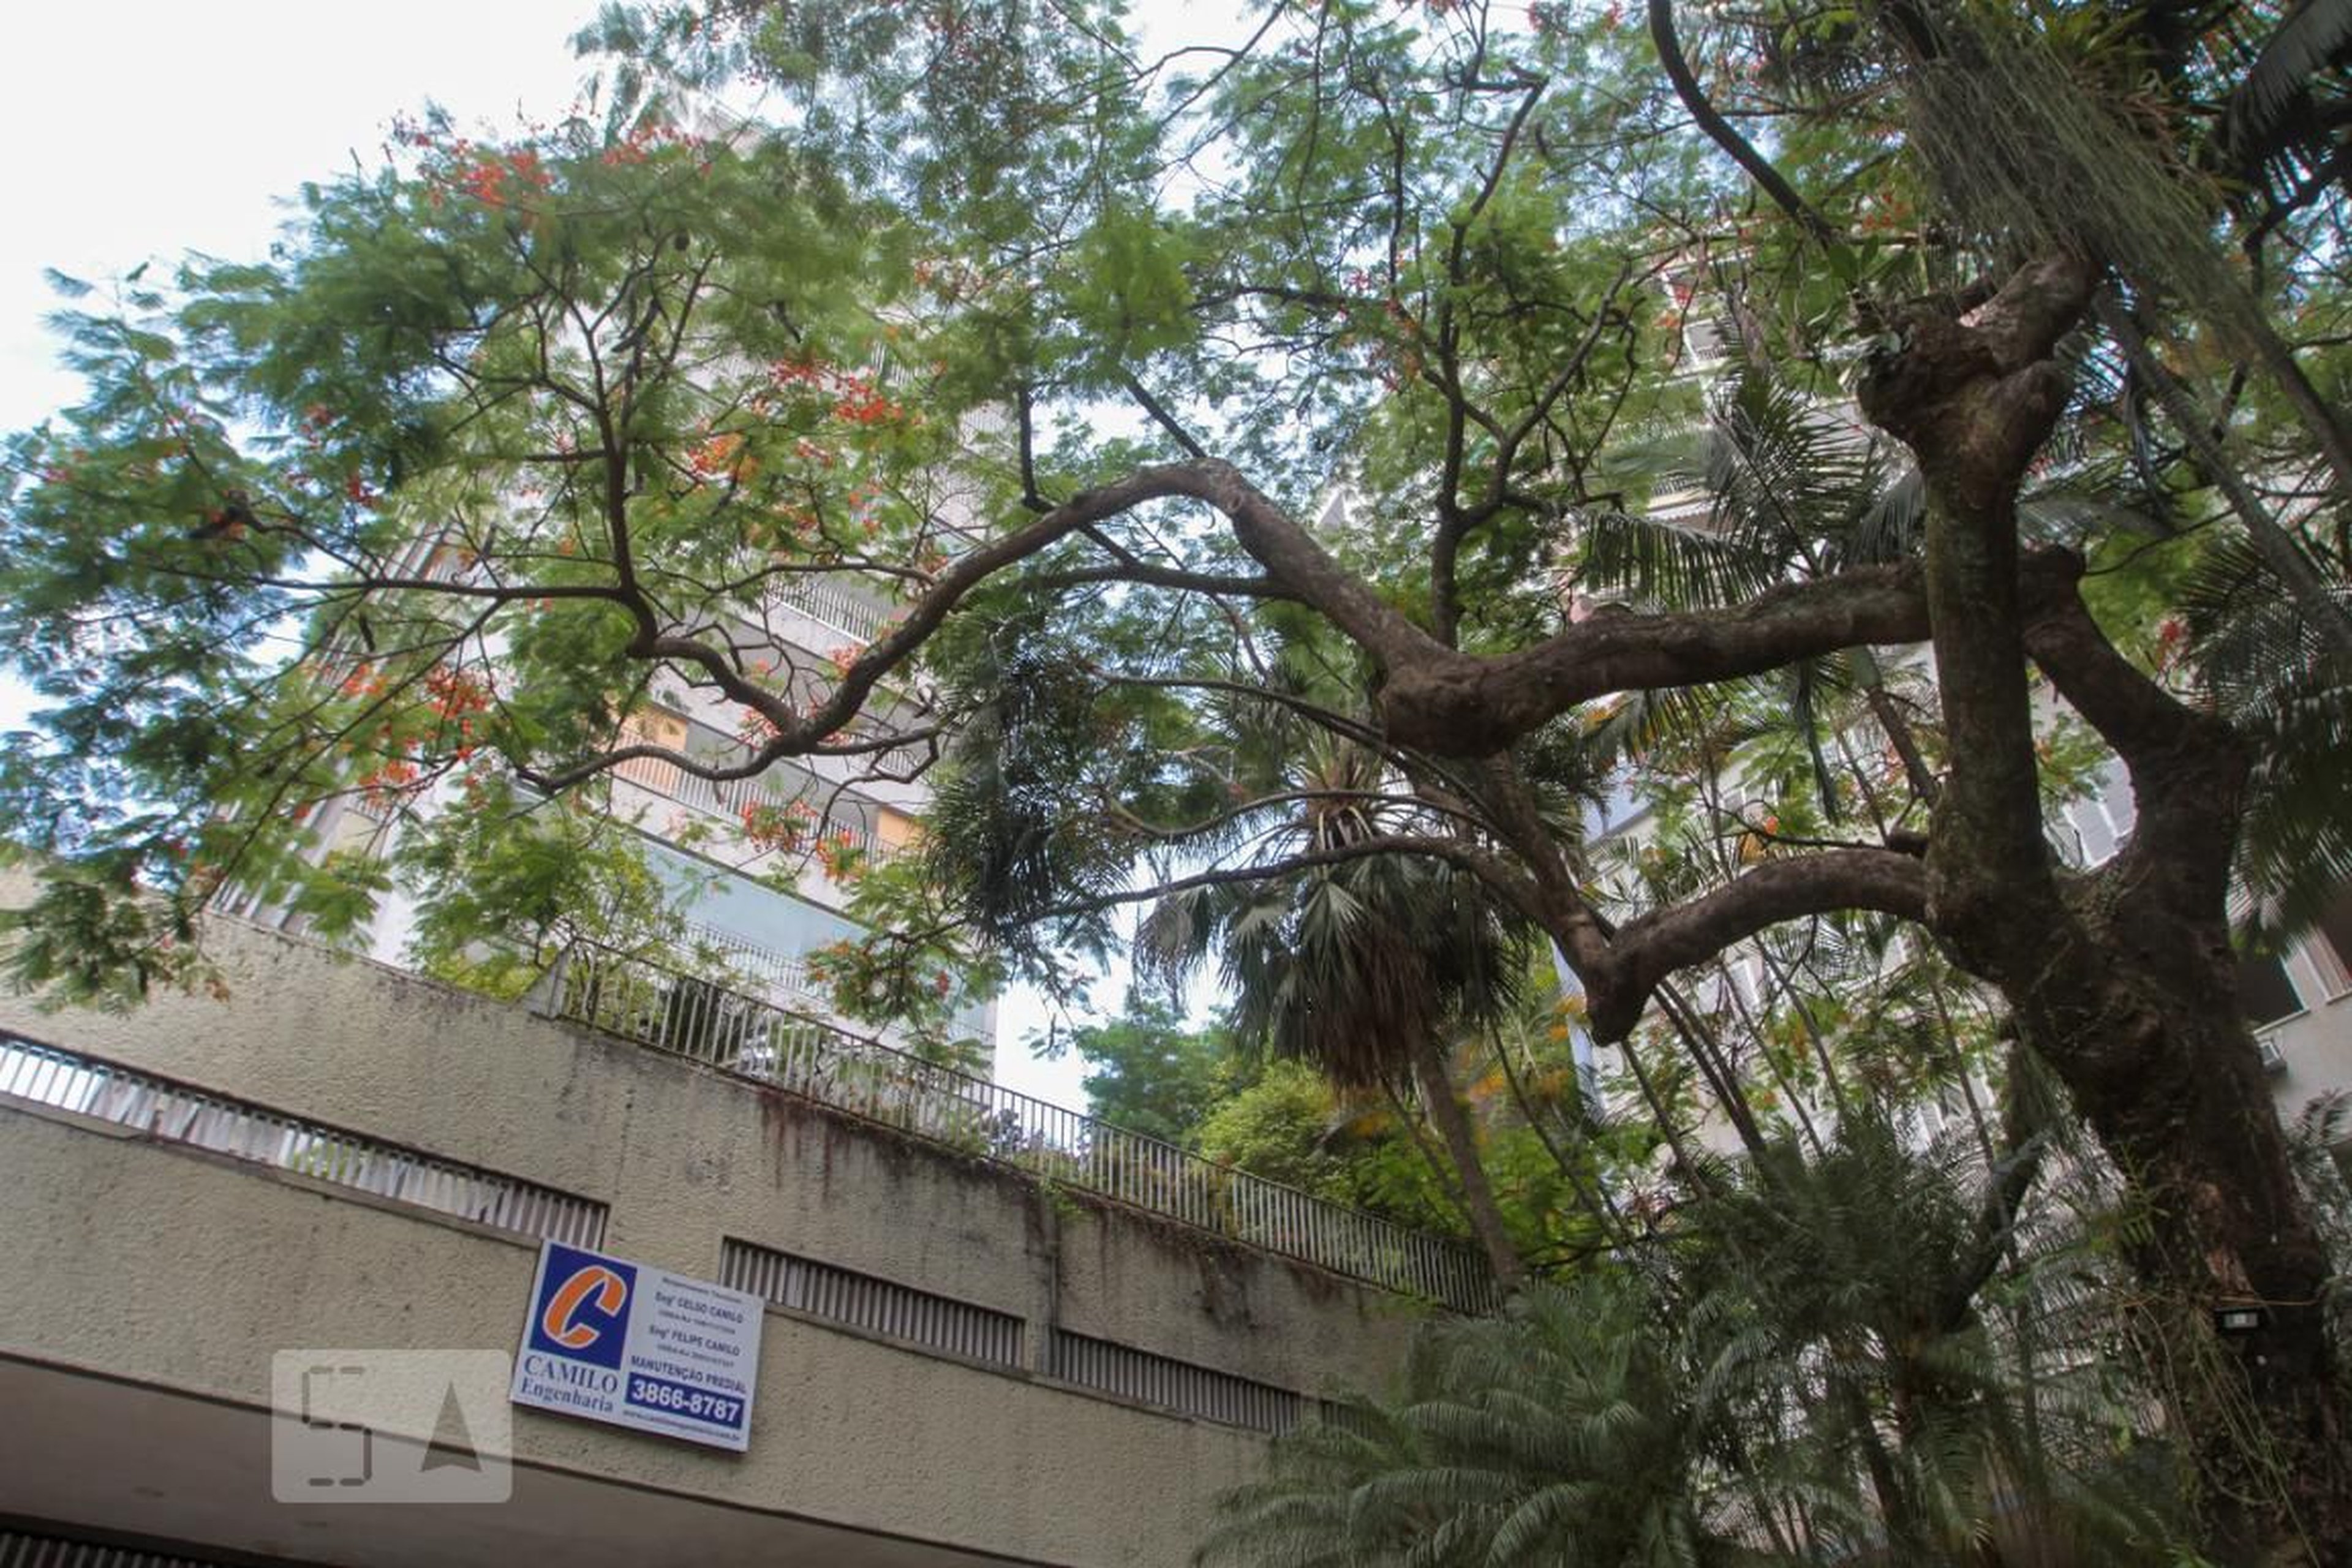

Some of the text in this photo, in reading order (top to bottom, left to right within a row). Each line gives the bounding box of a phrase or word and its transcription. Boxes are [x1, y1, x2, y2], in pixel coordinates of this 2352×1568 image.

[543, 1264, 628, 1349] C
[677, 1295, 707, 1314] CELSO
[709, 1305, 744, 1324] CAMILO
[671, 1330, 704, 1347] FELIPE
[705, 1338, 741, 1356] CAMILO
[524, 1355, 619, 1394] CAMILO
[631, 1354, 704, 1382] MANUTENÇÃO
[705, 1373, 748, 1393] PREDIAL
[521, 1376, 614, 1412] Engenharia
[631, 1379, 741, 1422] 3866-8787
